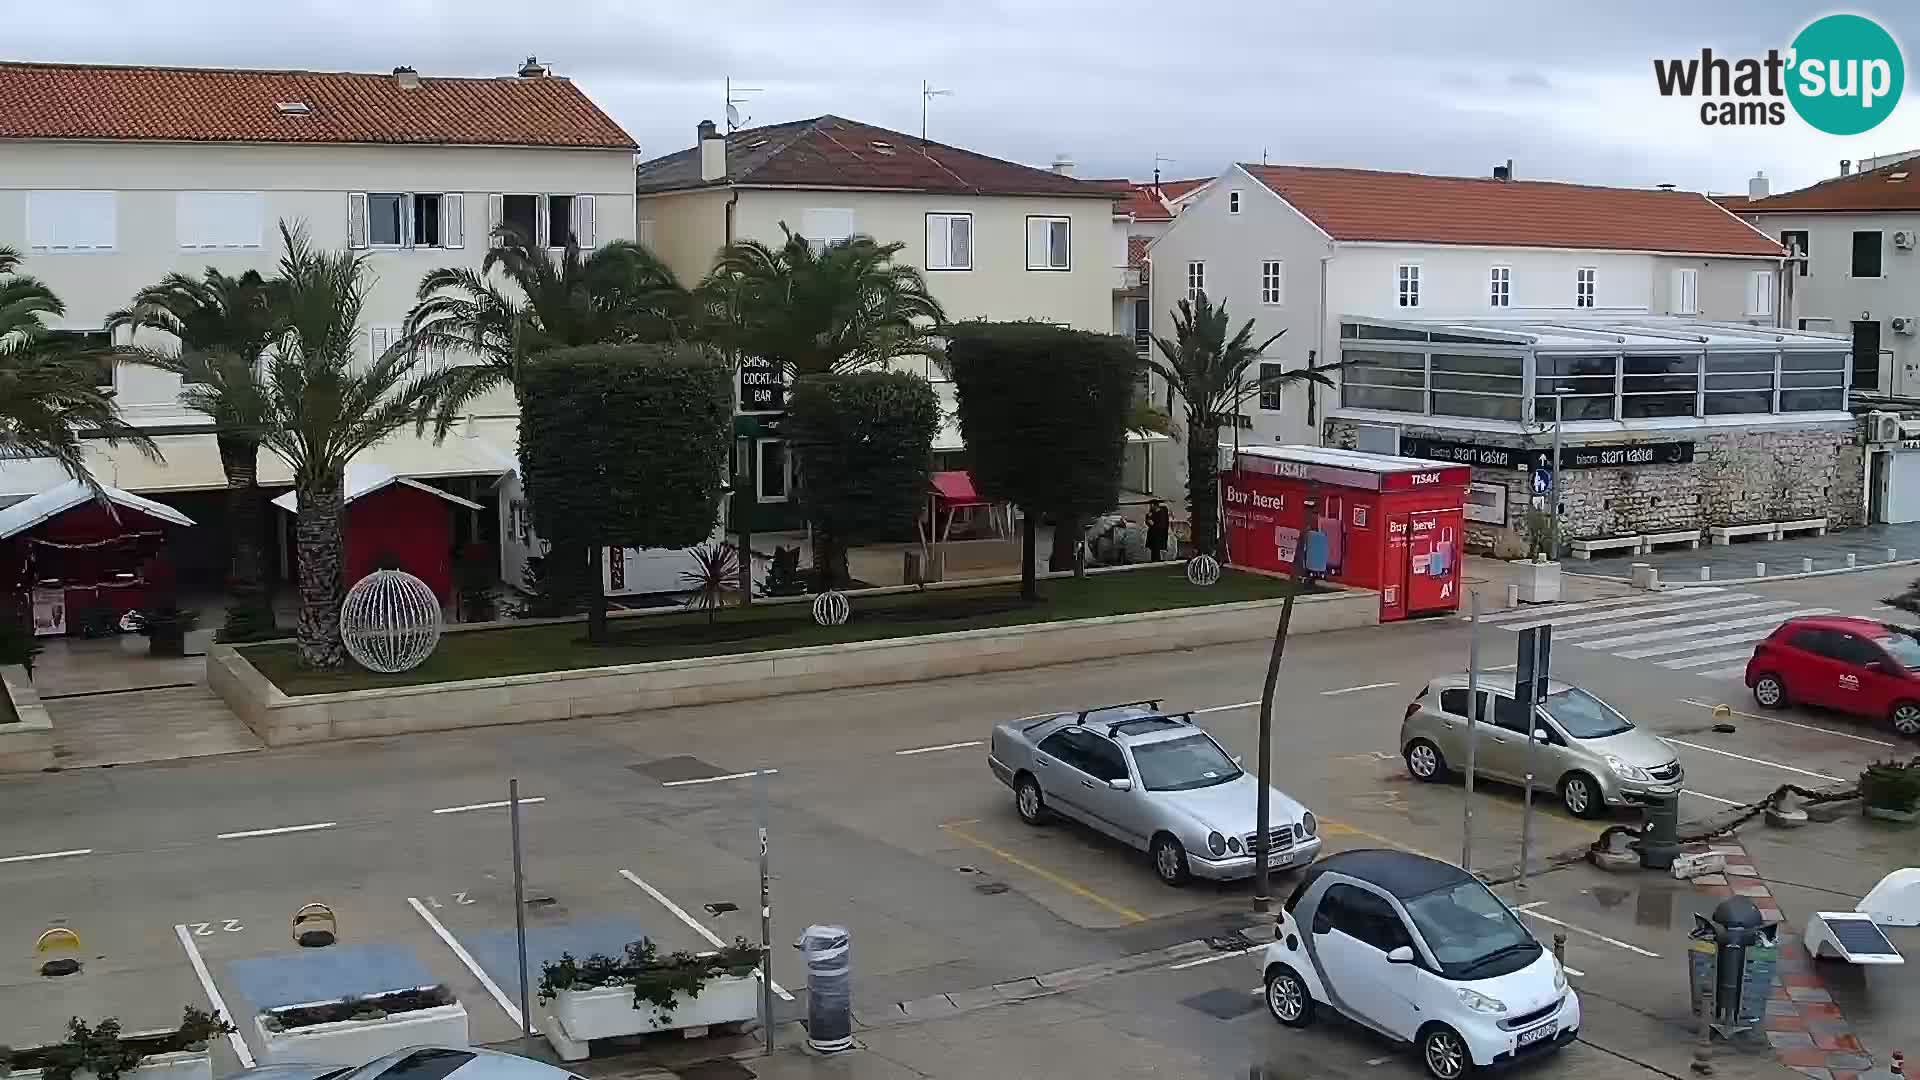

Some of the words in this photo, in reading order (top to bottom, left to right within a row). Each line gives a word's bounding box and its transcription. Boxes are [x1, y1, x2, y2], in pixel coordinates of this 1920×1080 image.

[754, 389, 772, 402] BAR
[1412, 472, 1440, 485] TISAK
[1252, 490, 1284, 511] here!
[1390, 521, 1408, 534] Buy
[1413, 518, 1436, 531] here!
